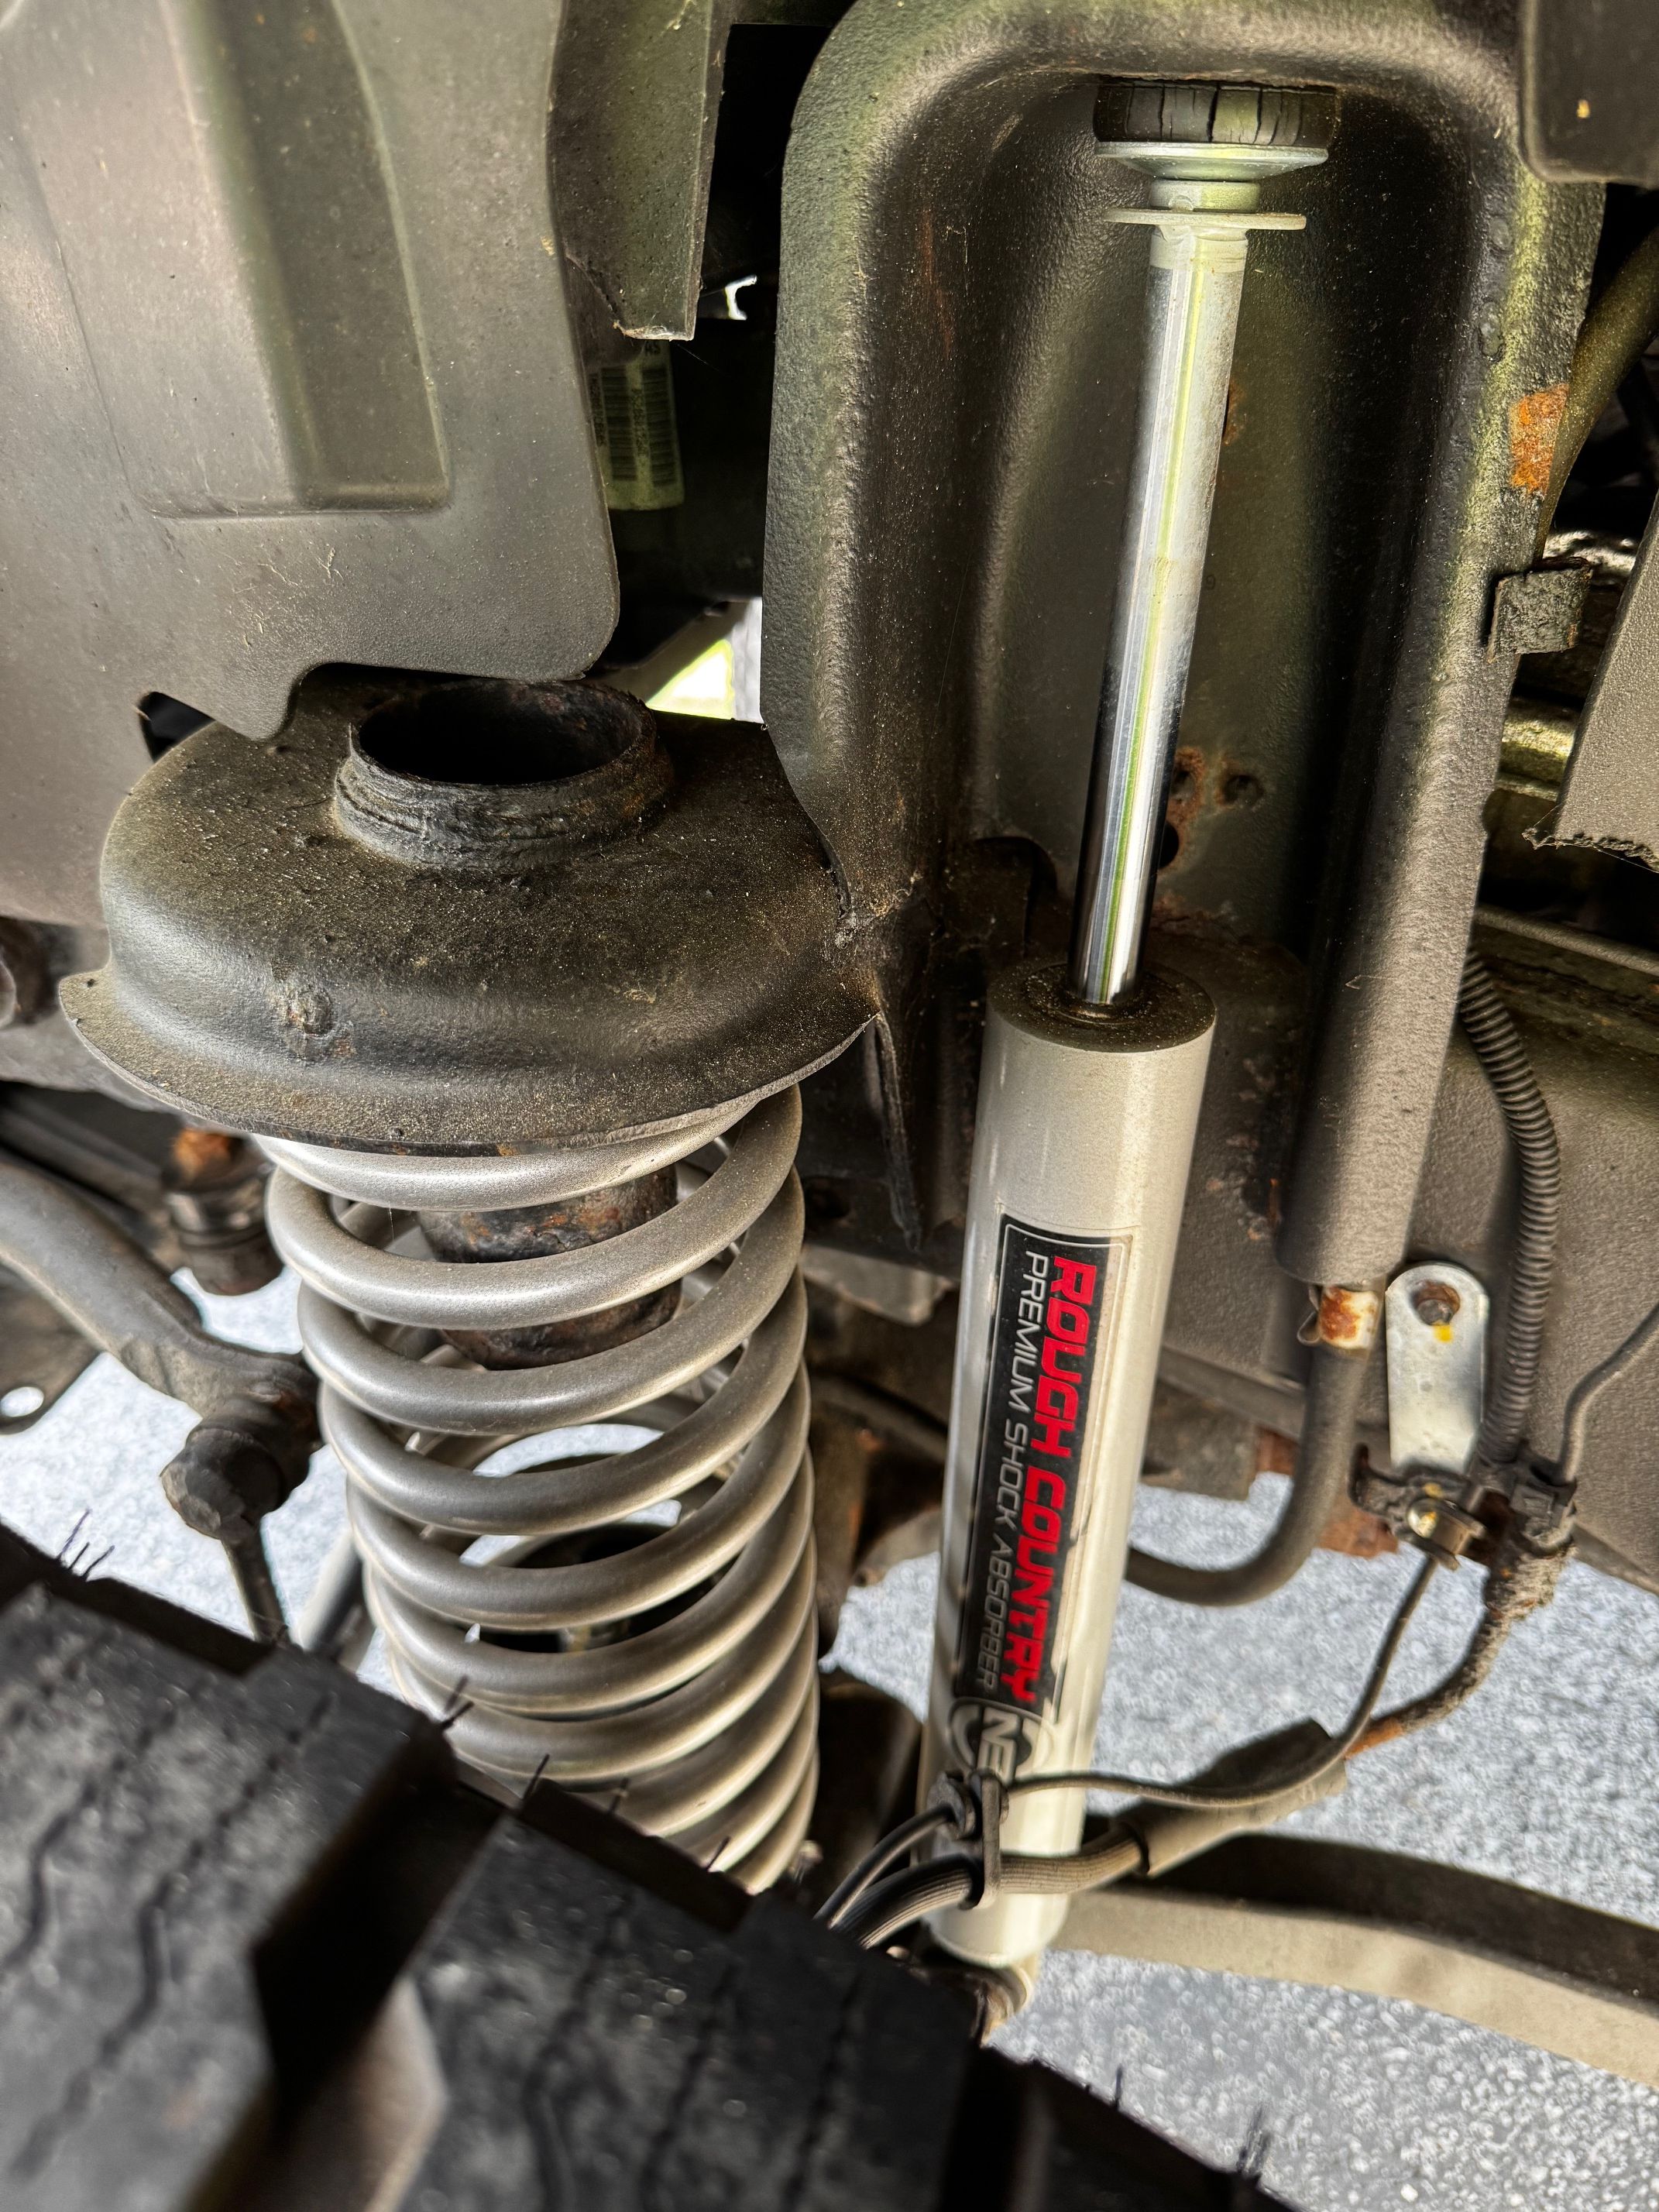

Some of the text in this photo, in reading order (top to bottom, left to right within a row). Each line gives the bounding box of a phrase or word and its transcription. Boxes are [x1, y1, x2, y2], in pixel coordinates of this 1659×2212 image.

[977, 1250, 1049, 1692] PREMIUM SHOCK ABSORBER
[1001, 1255, 1097, 1702] ROUGH COUNTRY
